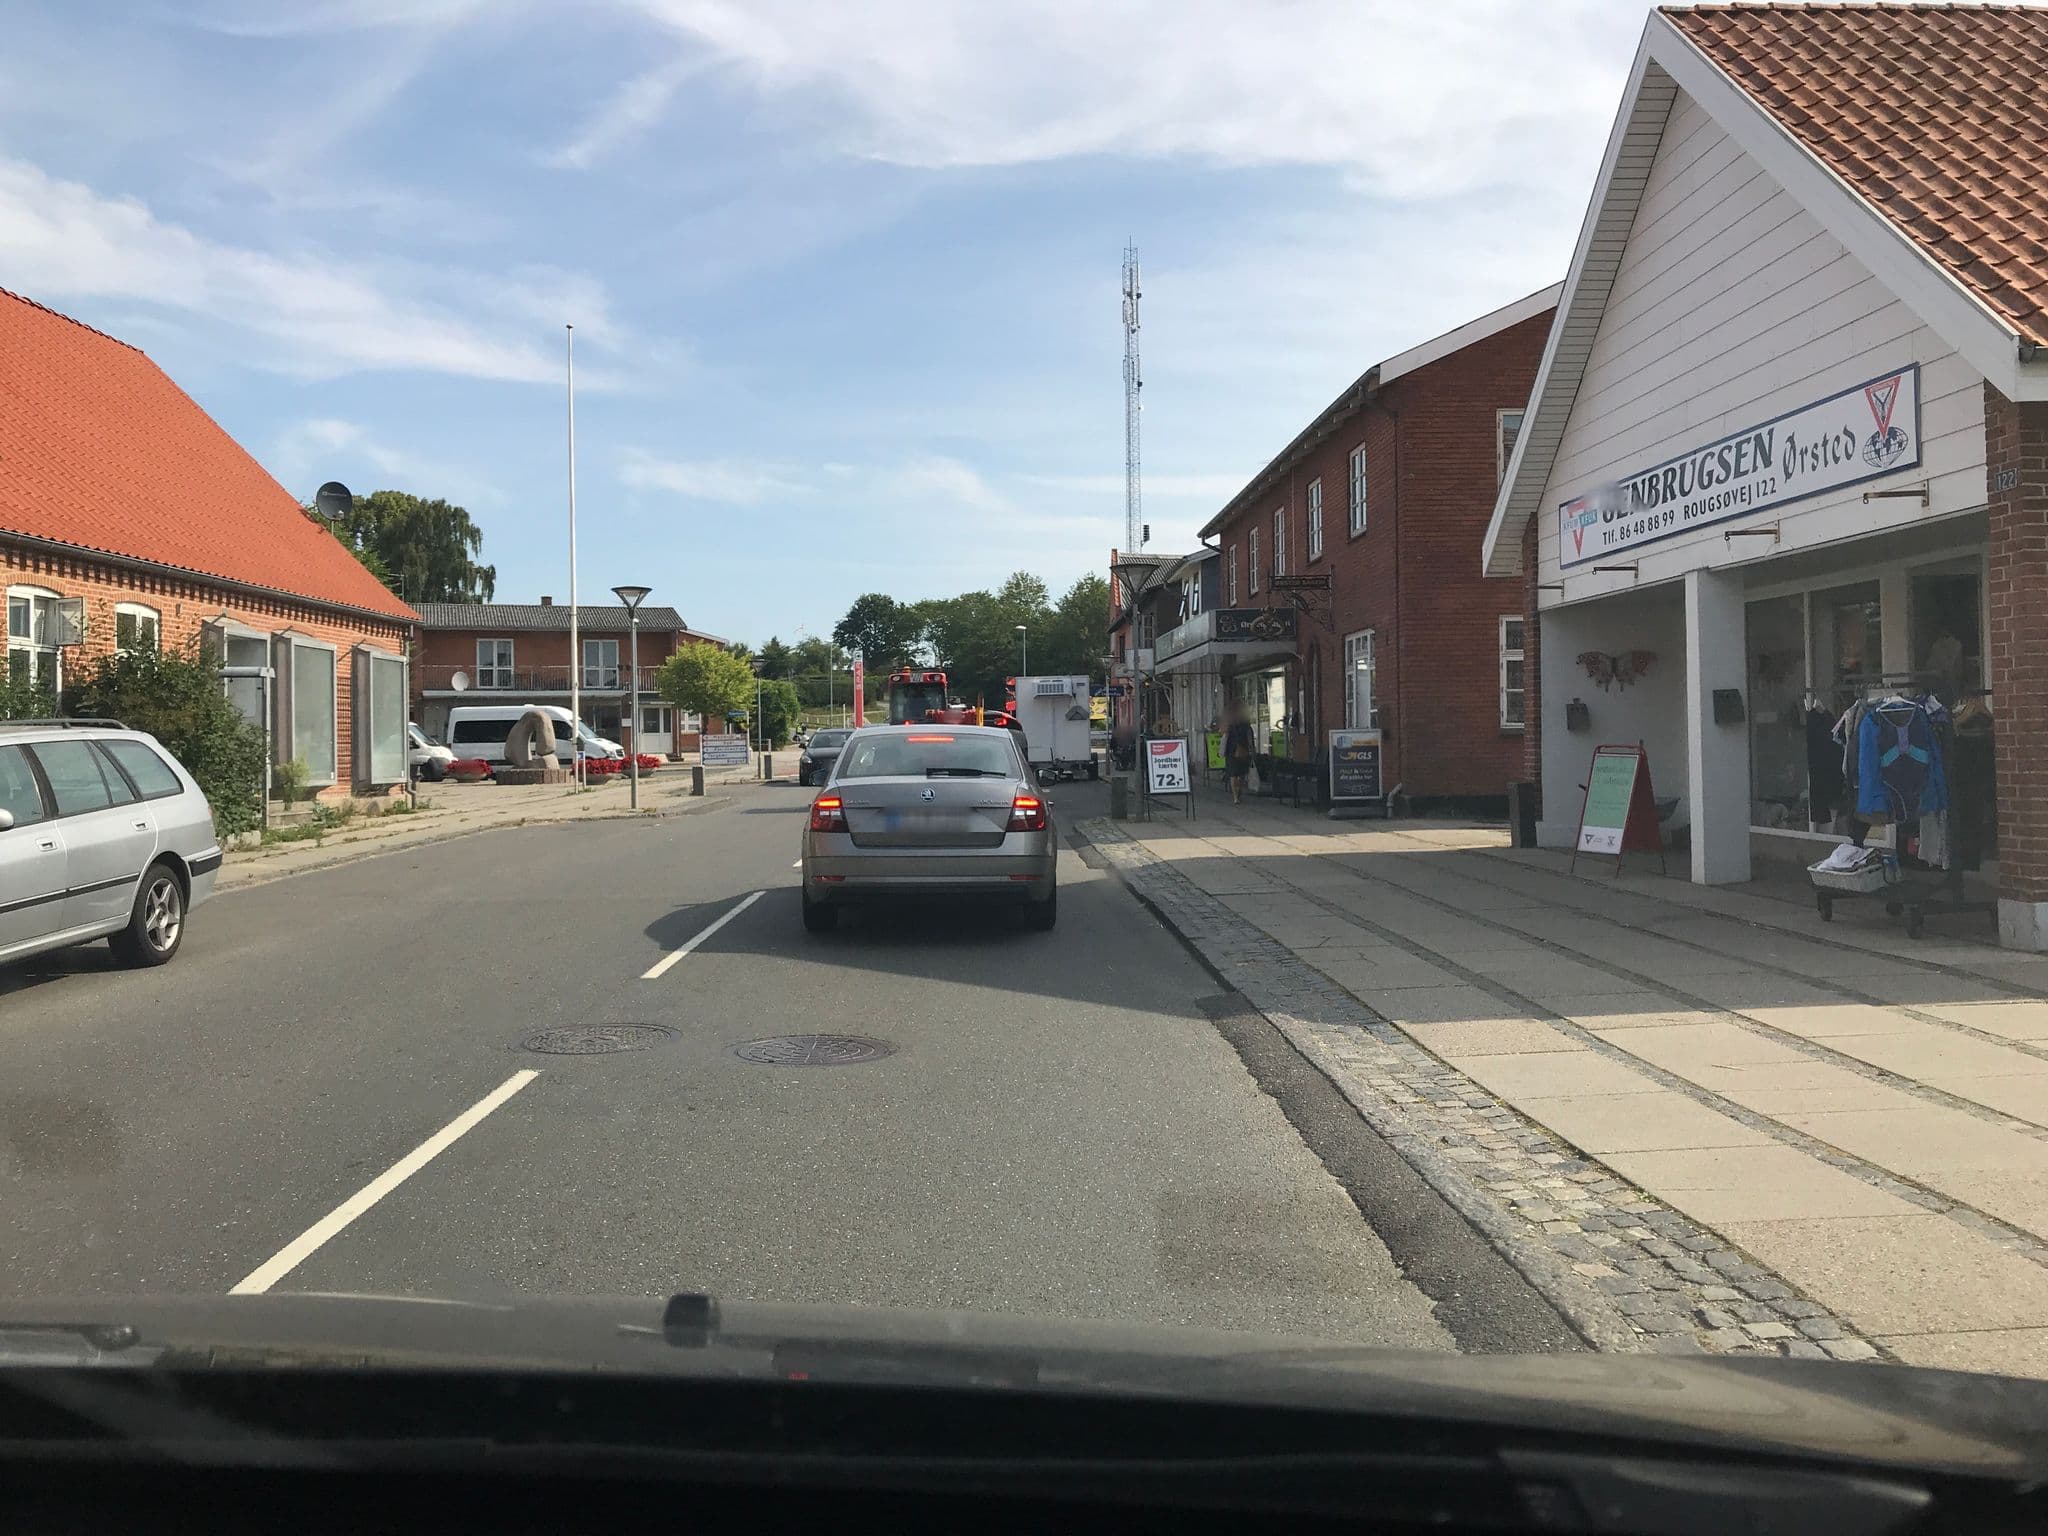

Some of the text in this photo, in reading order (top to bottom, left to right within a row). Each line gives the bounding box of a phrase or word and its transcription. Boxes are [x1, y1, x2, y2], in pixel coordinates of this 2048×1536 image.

[1783, 424, 1856, 483] Ørsted
[1603, 477, 1776, 545] Tlf. 86 48 88 99 ROUGSØVEJ 122
[1357, 751, 1372, 759] GLS
